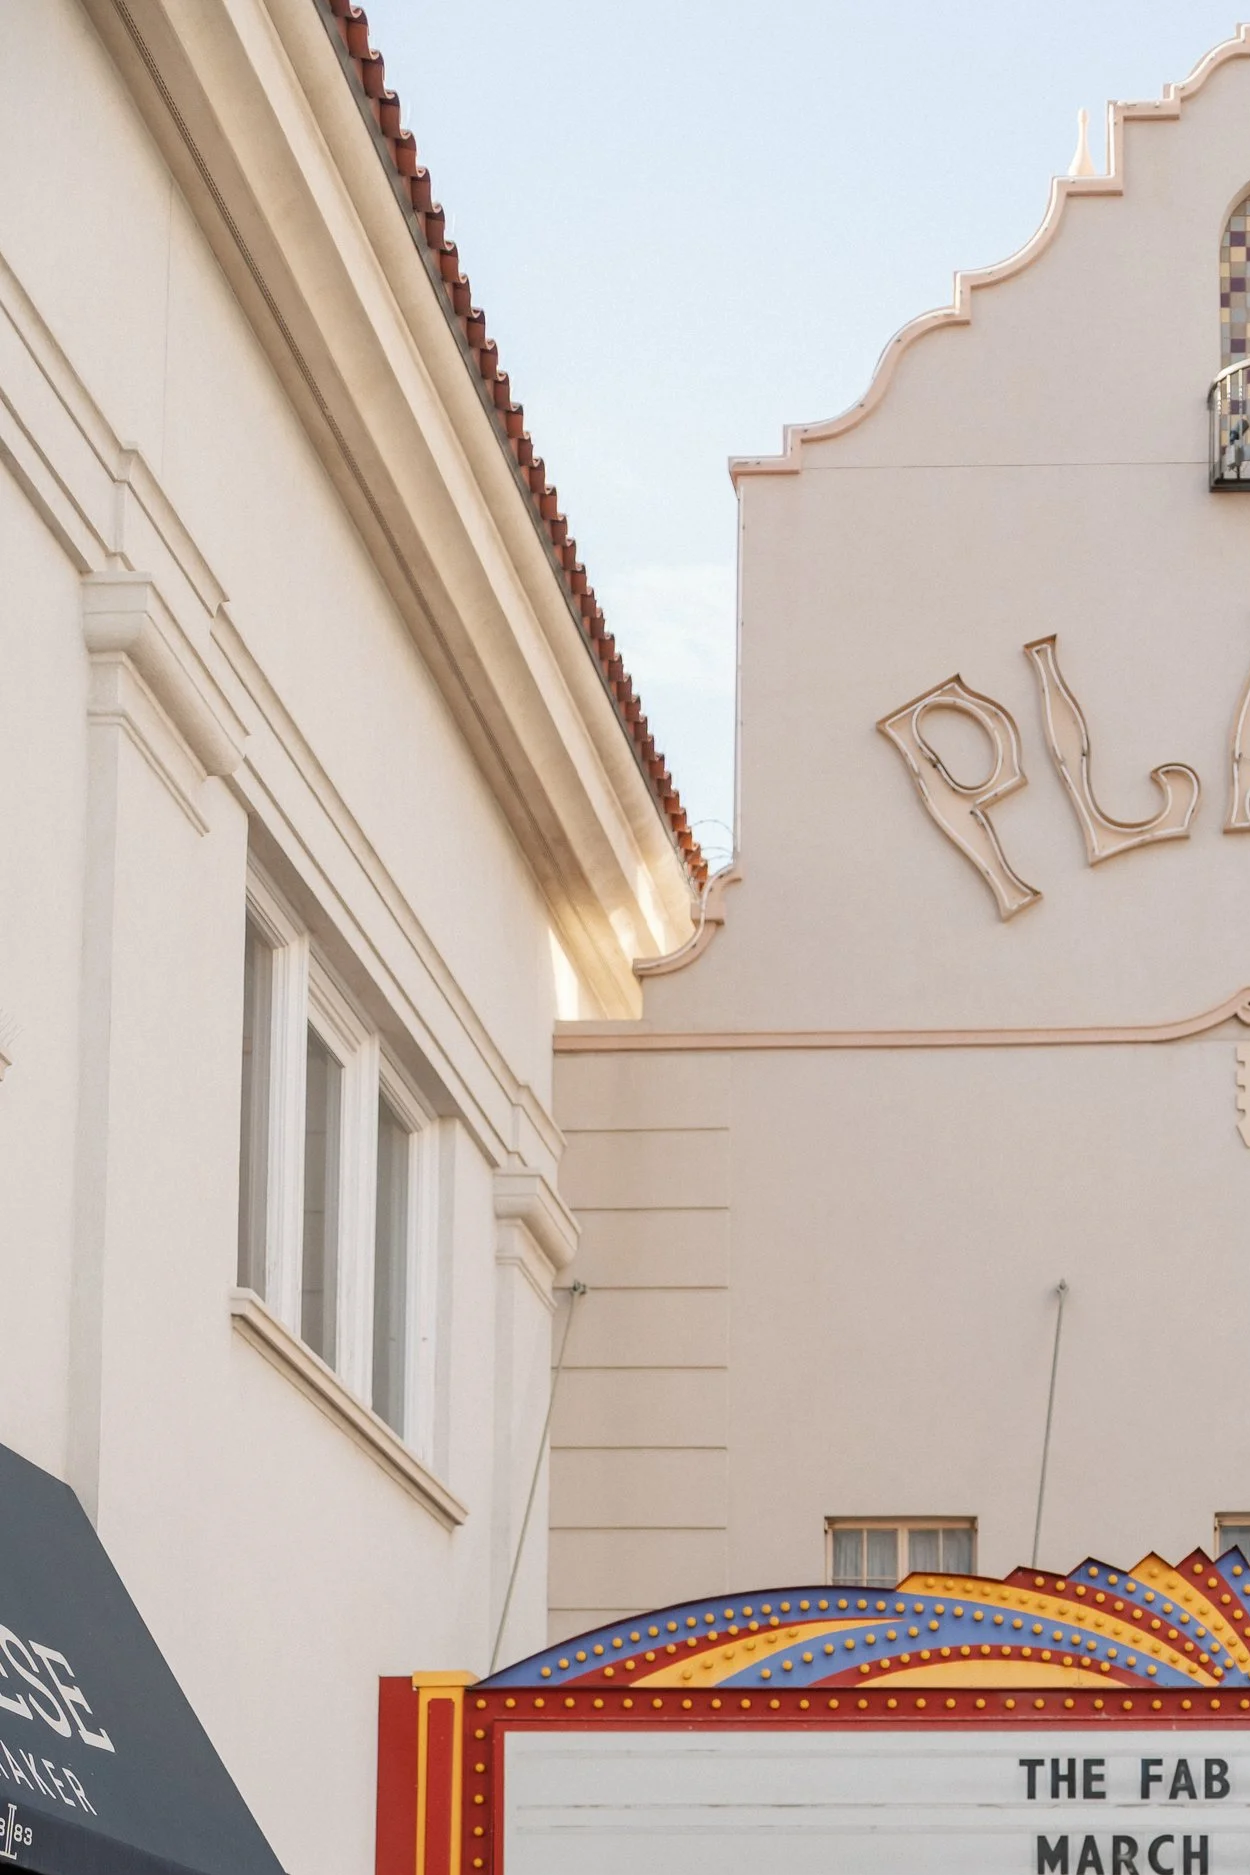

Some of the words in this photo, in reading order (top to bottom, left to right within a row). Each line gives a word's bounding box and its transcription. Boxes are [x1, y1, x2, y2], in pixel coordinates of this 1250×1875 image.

[0, 1739, 98, 1816] AKER
[1019, 1758, 1107, 1800] THE
[1140, 1758, 1231, 1800] FAB
[1036, 1834, 1210, 1875] MARCH
